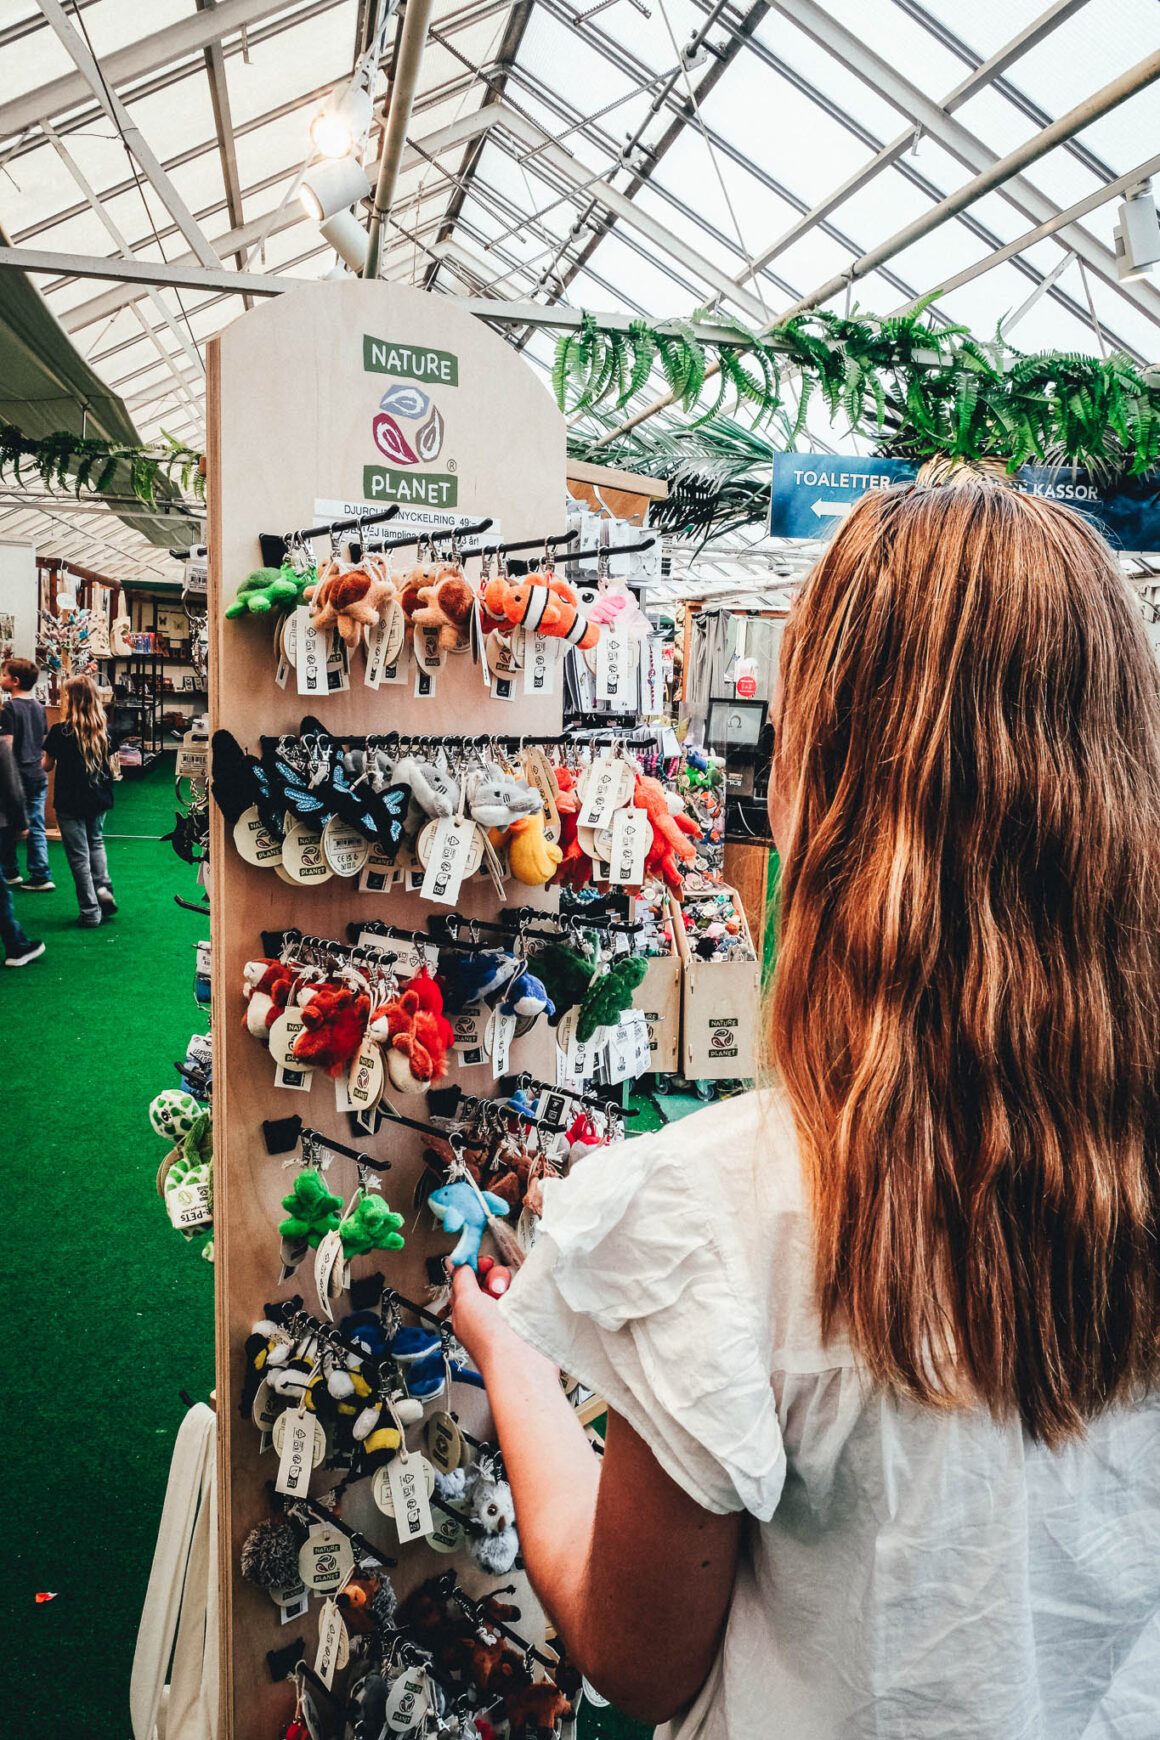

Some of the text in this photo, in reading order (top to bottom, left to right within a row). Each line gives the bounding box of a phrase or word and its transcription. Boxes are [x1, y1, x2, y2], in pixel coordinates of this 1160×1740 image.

[372, 343, 452, 380] NATURE
[793, 470, 891, 490] TOALETTER
[371, 473, 451, 504] PLANET
[1033, 483, 1099, 500] KASSOR
[300, 867, 326, 875] PLANET
[711, 1019, 737, 1027] NATURE
[711, 1049, 736, 1057] PLANET
[314, 1545, 339, 1553] NATURE
[314, 1573, 339, 1582] PLANET
